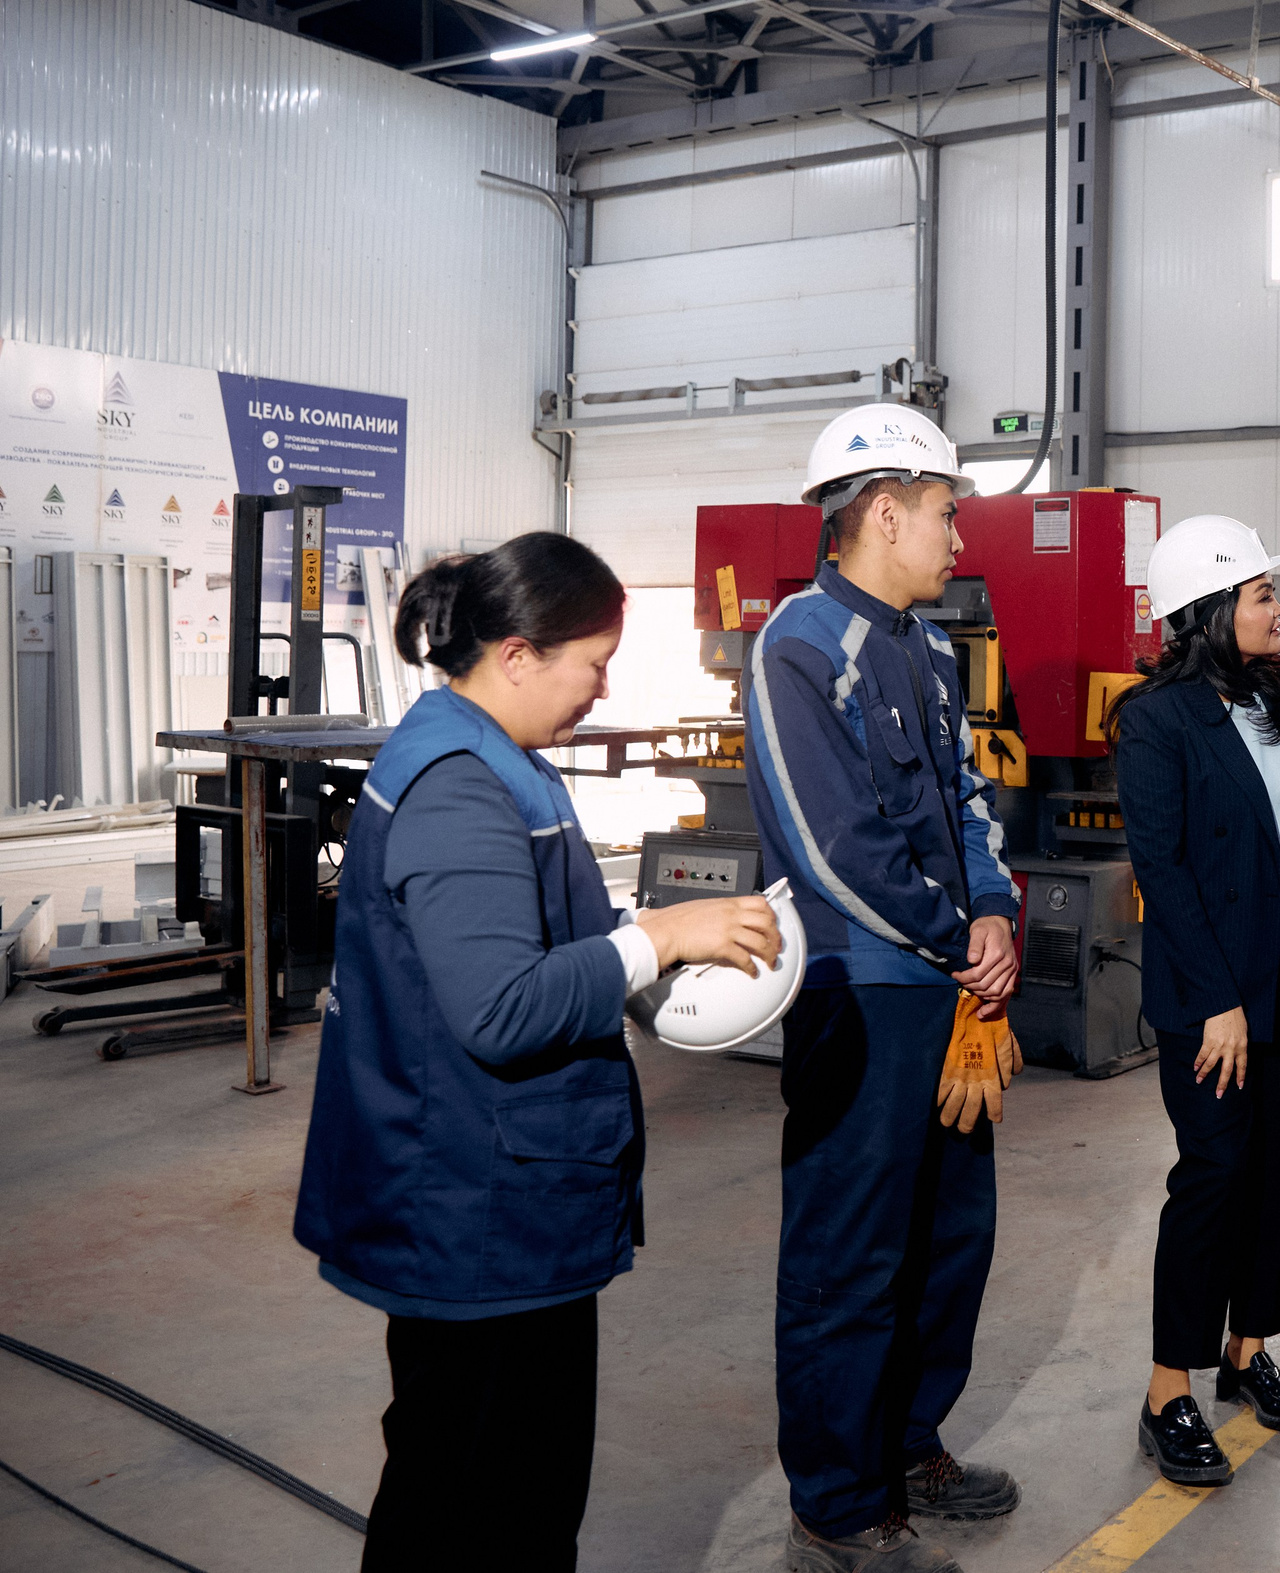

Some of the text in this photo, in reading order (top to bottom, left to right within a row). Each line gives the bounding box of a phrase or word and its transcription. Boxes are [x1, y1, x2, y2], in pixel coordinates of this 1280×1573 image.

[97, 408, 136, 428] SKY
[248, 400, 398, 436] ЦЕЛЬ КОМПАНИИ
[284, 434, 329, 446] ПРОИЗВОДСТВО
[13, 446, 50, 455] СОЗДАНИЕ
[284, 443, 320, 453] ПРОДУКЦИИ
[289, 462, 376, 478] ВНЕДРЕНИЕ НОВЫХ ТЕХНОЛОГИЙ
[371, 492, 385, 500] МЕСТ
[42, 505, 65, 516] SKY
[104, 509, 126, 519] SKY
[161, 514, 182, 525] SKY
[325, 527, 354, 536] NDUSTRIAL
